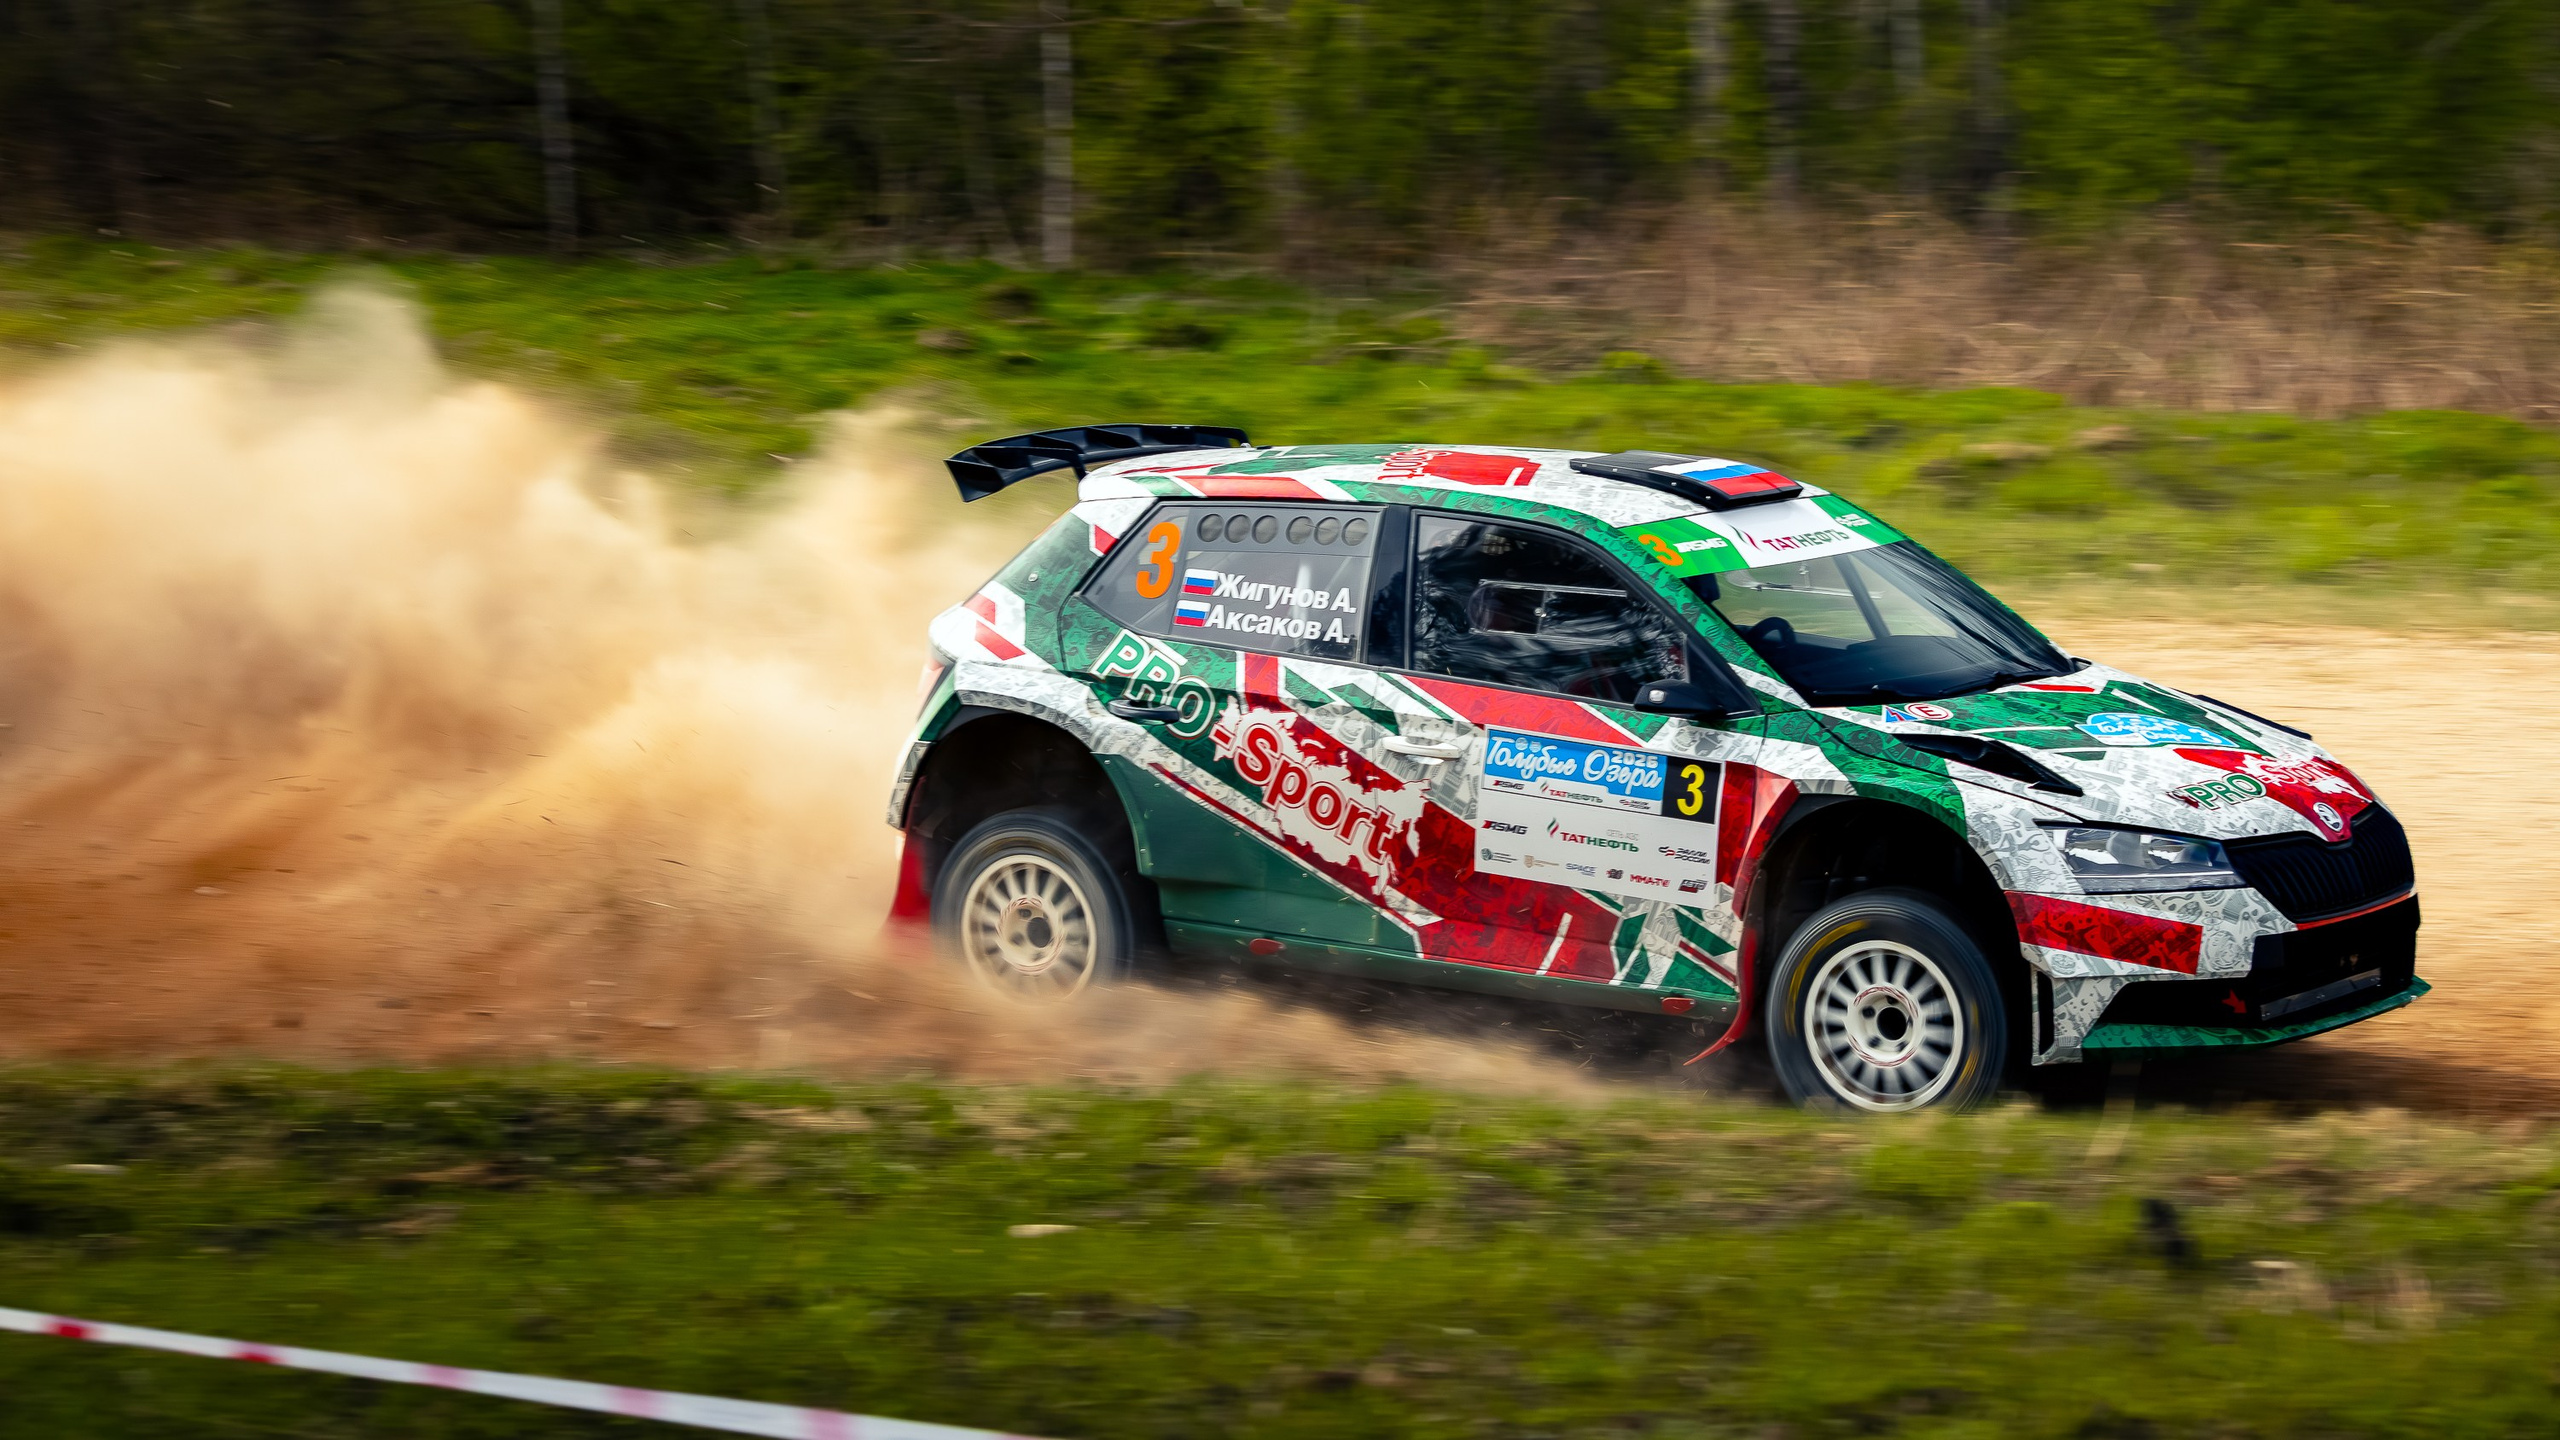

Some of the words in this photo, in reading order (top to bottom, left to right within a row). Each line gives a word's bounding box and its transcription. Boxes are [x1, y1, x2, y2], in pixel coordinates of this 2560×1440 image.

[1638, 534, 1684, 566] 3
[1762, 528, 1850, 551] ТАТНЕФТЬ
[1136, 522, 1181, 599] 3
[1212, 572, 1330, 612] Жигунов
[1329, 587, 1357, 614] А.
[1203, 605, 1321, 641] Аксаков
[1323, 617, 1350, 644] А.
[1915, 706, 1942, 717] E
[1486, 736, 1577, 779] Голубые
[1549, 789, 1604, 804] ТАТНЕФТЬ
[1677, 764, 1705, 816] 3
[1560, 831, 1639, 852] ТАТНЕФТЬ
